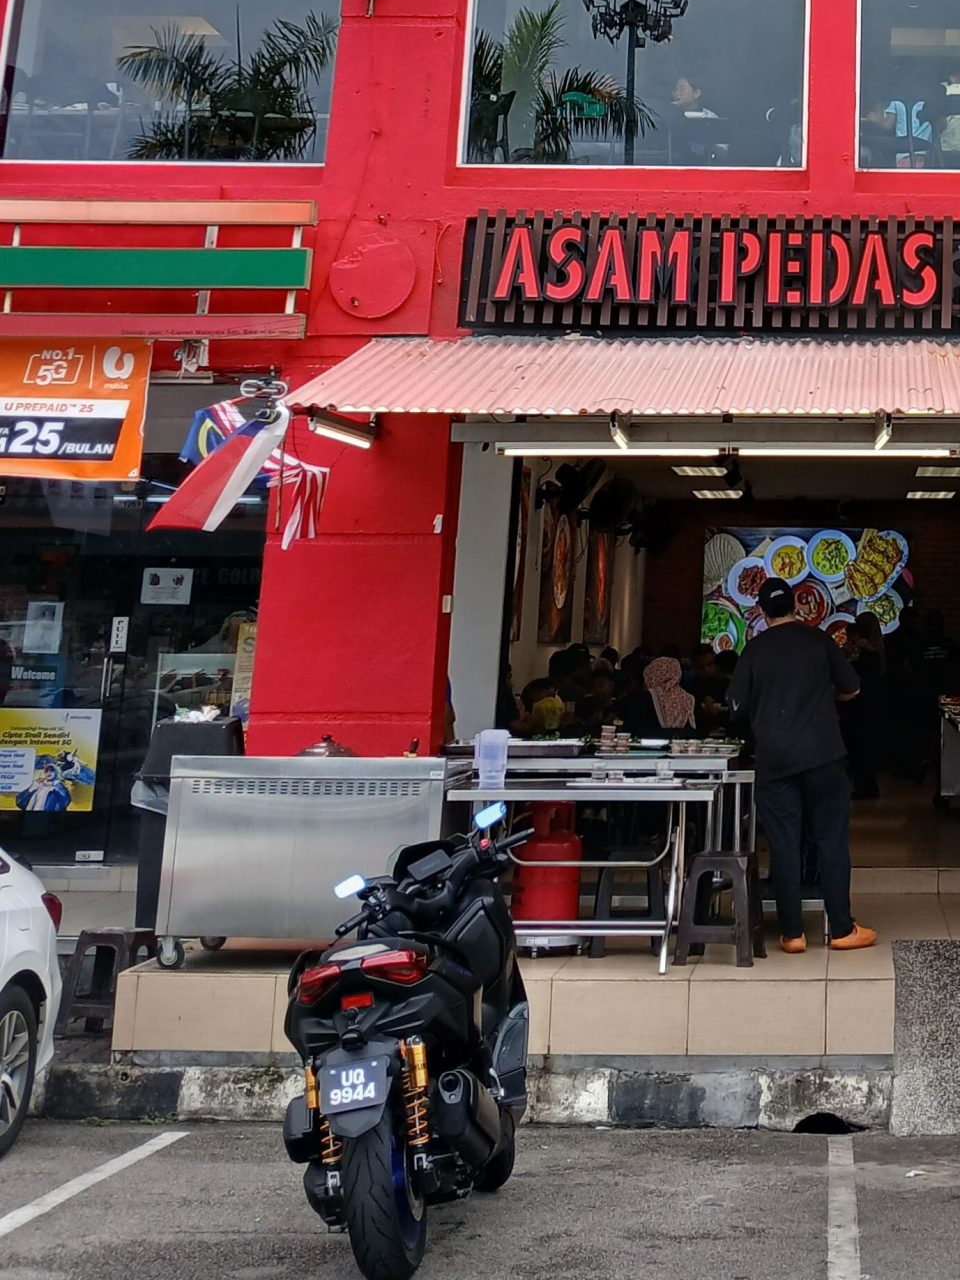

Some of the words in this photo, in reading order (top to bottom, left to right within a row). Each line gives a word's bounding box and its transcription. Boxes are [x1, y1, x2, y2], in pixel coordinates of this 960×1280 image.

[492, 223, 692, 306] ASAM
[718, 228, 941, 309] PEDAS
[41, 347, 75, 360] NO.1
[35, 360, 68, 386] 5G
[103, 381, 129, 390] mobile
[4, 402, 13, 411] U
[79, 404, 95, 413] 25
[11, 665, 56, 680] Welcome
[341, 1068, 366, 1087] UQ
[329, 1082, 376, 1106] 9944
